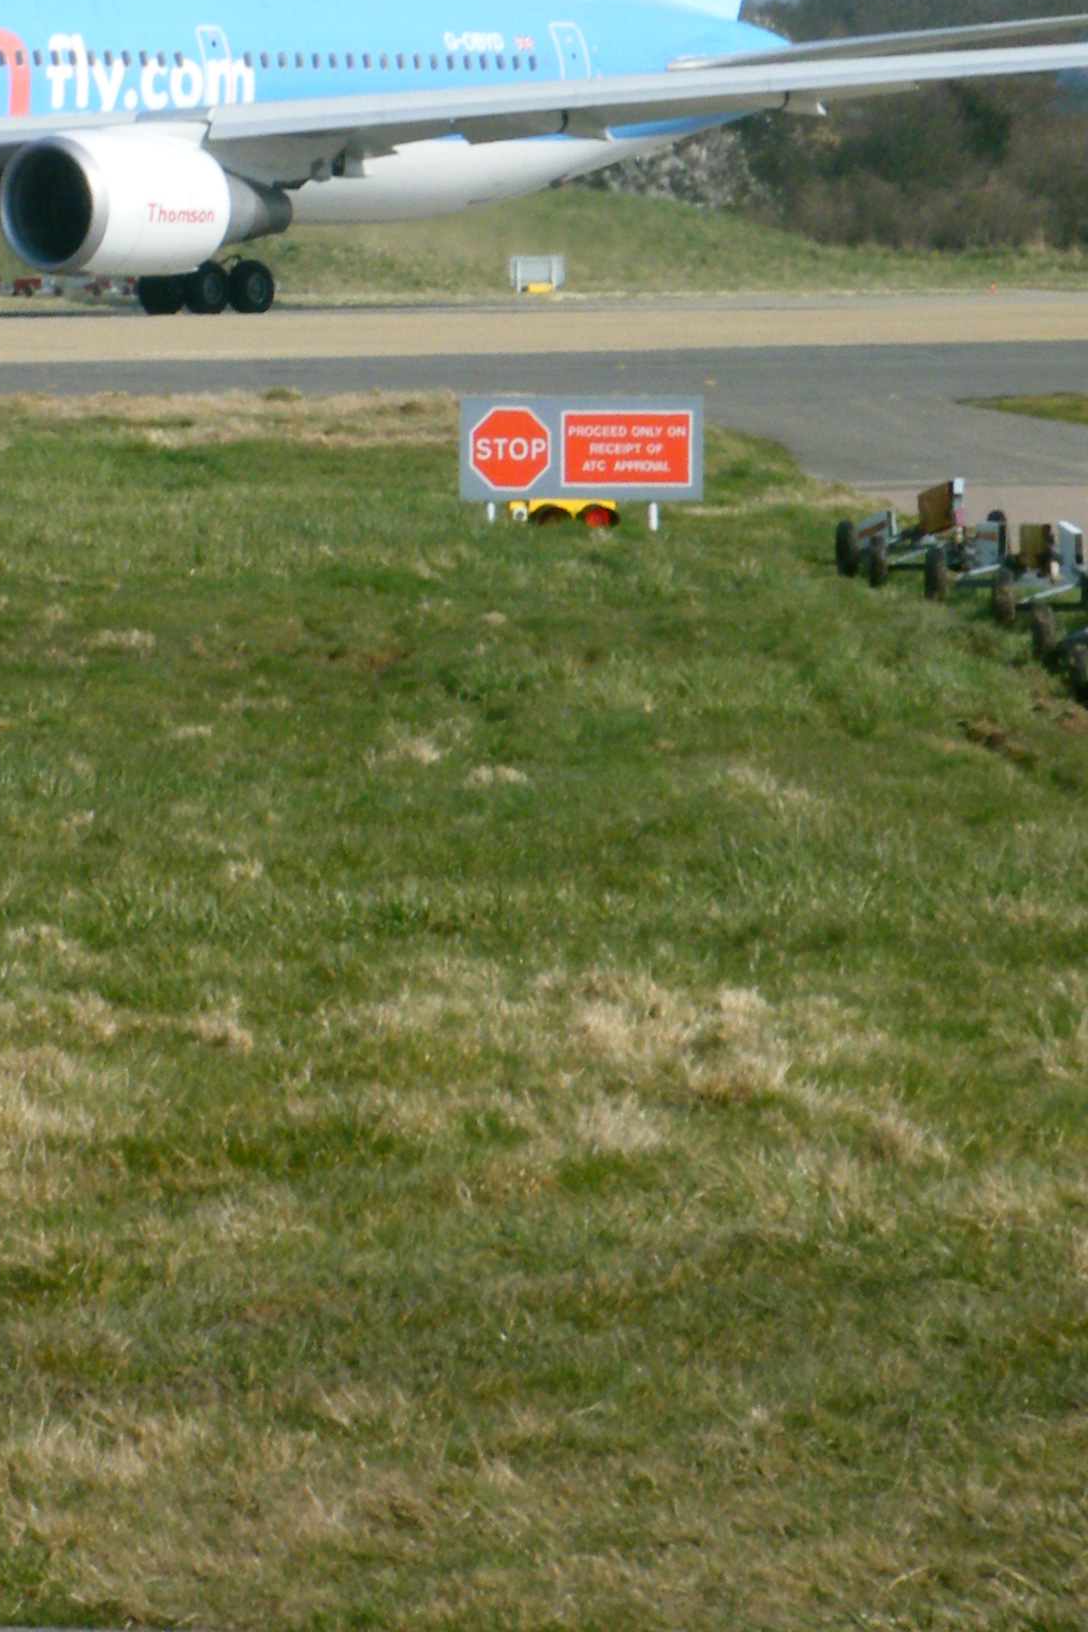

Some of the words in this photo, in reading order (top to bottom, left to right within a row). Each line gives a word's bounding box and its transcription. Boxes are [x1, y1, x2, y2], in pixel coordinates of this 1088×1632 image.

[147, 201, 215, 224] Thomson
[568, 425, 628, 437] PROCEED
[631, 425, 662, 437] ONLY
[667, 425, 687, 437] ON
[476, 437, 547, 461] STOP
[589, 443, 642, 455] RECEIPT
[646, 443, 664, 455] OF
[582, 460, 606, 472] ATC
[613, 460, 671, 472] APPROVAL
